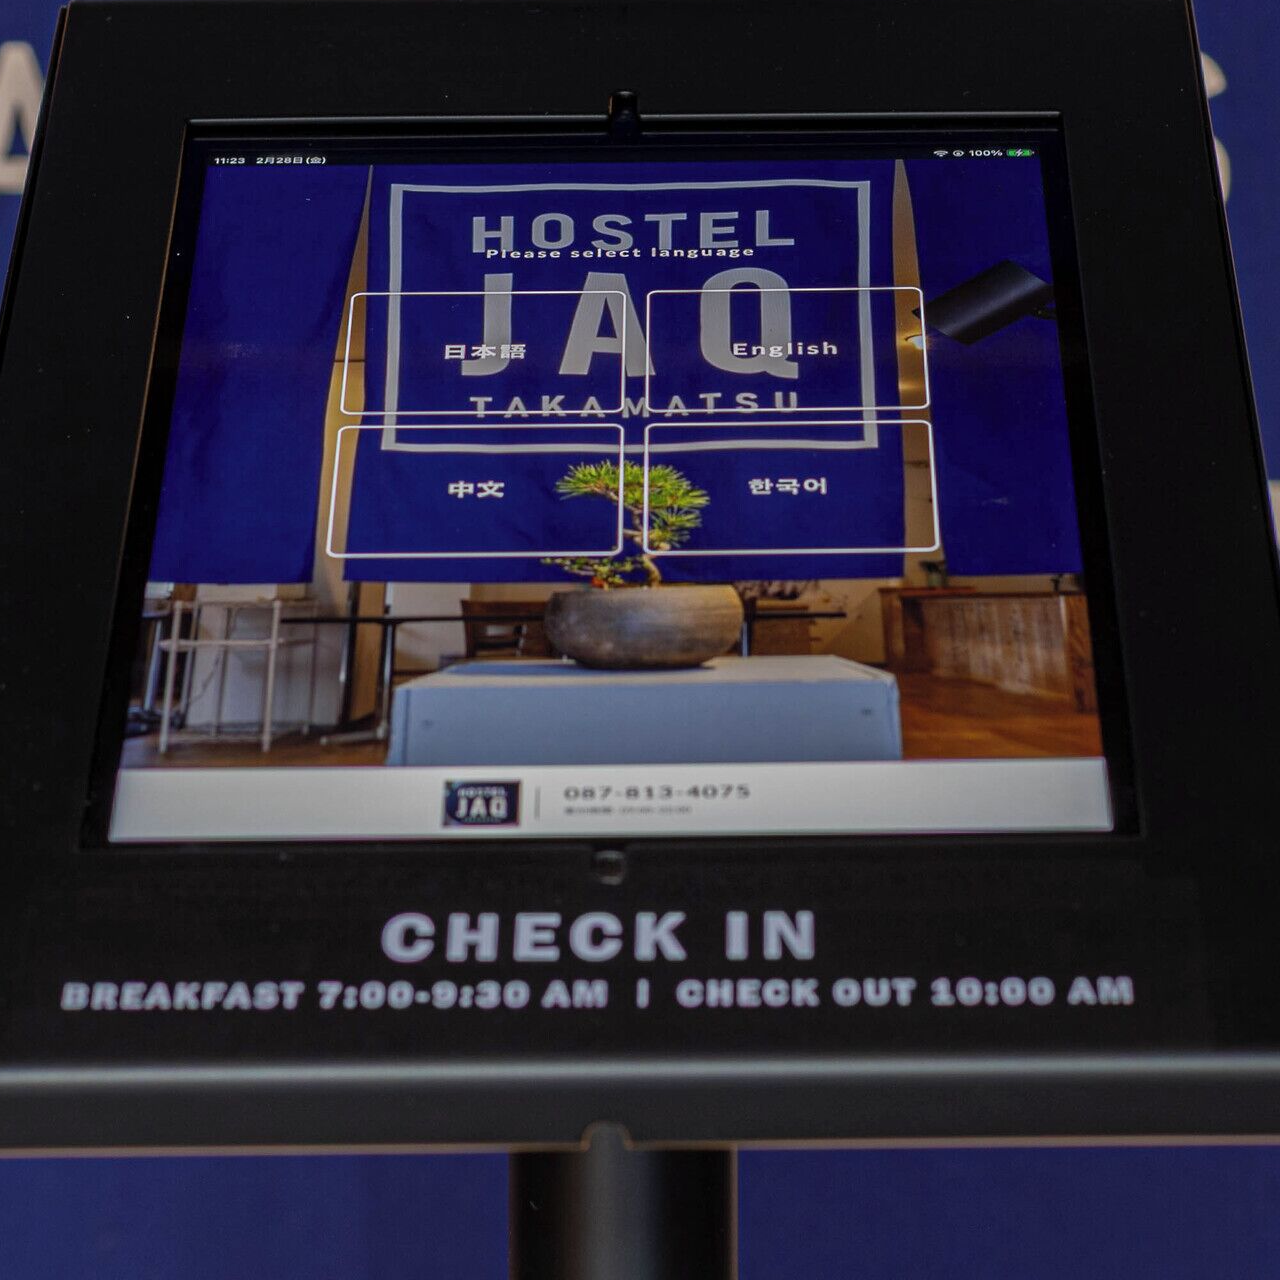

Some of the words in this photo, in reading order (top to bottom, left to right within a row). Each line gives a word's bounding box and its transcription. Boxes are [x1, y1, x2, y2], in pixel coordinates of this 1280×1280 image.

[214, 157, 246, 165] 11:23
[968, 149, 1003, 157] 100%
[472, 209, 796, 253] HOSTEL
[486, 248, 561, 259] Please
[570, 248, 641, 258] select
[651, 246, 754, 259] language
[461, 267, 799, 380] JAQ
[444, 343, 527, 360] 日本語
[732, 341, 838, 358] English
[469, 390, 799, 419] TAKAMATSU
[448, 480, 505, 499] 中文
[748, 477, 828, 496] 한국어
[563, 784, 751, 801] 087-813-4075
[455, 796, 508, 819] JAQ
[381, 911, 687, 963] CHECK
[725, 910, 815, 961] IN
[60, 980, 305, 1011] BREAKFAST
[317, 979, 530, 1010] 7:00-9:30
[541, 979, 609, 1009] AM
[675, 978, 820, 1008] CHECK
[832, 977, 917, 1007] OUT
[930, 976, 1055, 1006] 10:00
[1067, 976, 1134, 1005] AM
